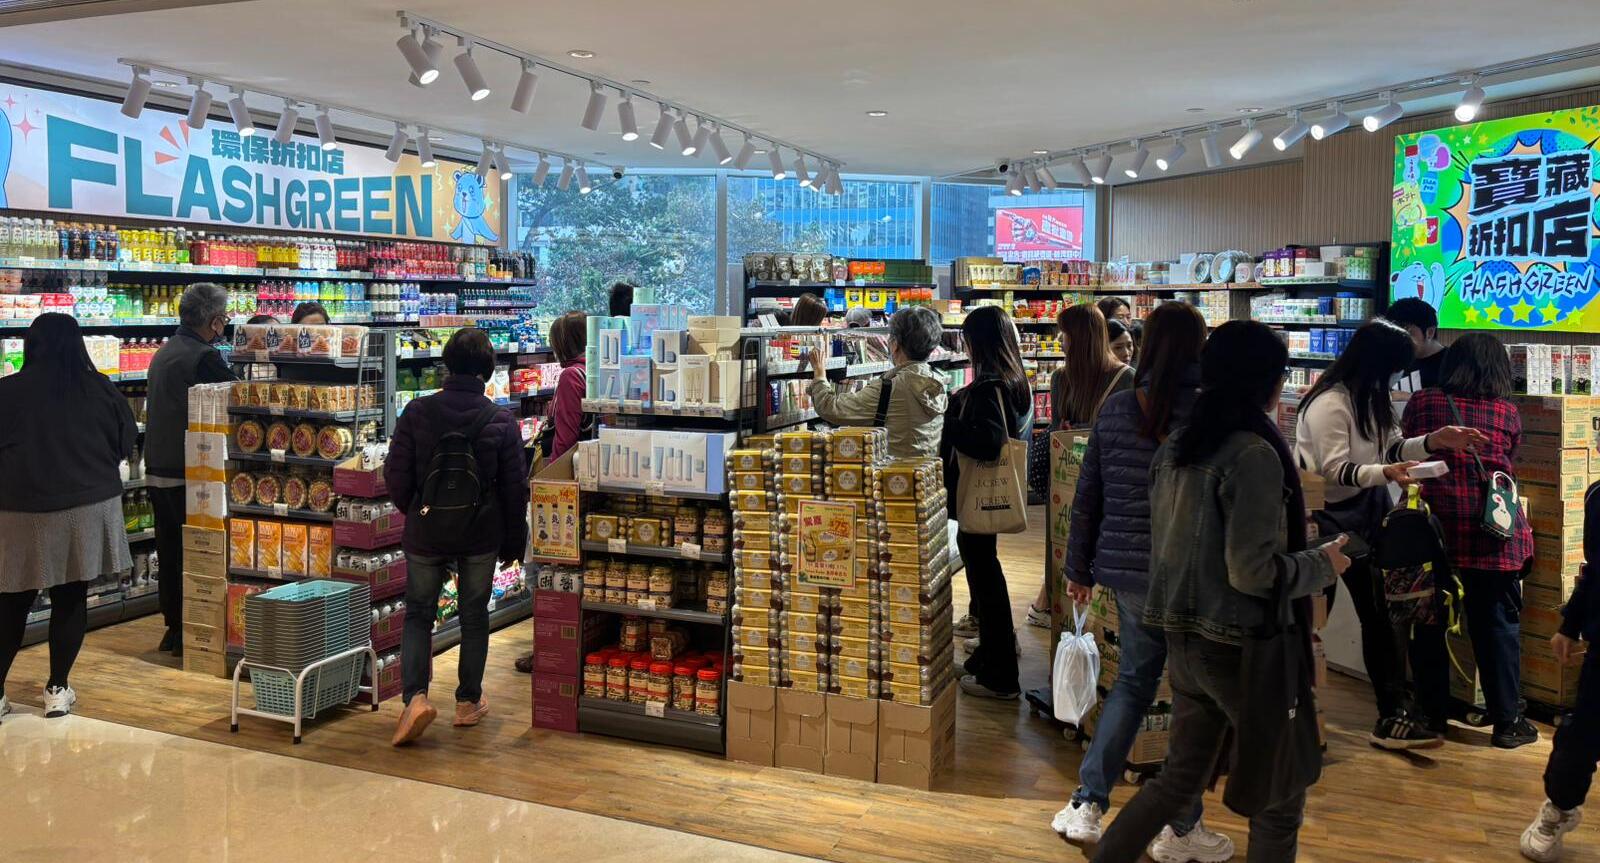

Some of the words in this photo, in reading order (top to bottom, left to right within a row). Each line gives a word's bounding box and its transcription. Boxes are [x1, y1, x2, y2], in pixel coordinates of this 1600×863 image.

[47, 115, 432, 237] FLASHGREEN
[211, 129, 344, 175] 環保折扣店
[1468, 152, 1591, 216] 寶藏
[1468, 199, 1591, 258] 折扣店
[1463, 272, 1592, 298] FLASHGREEN
[974, 478, 1009, 488] J.CREW
